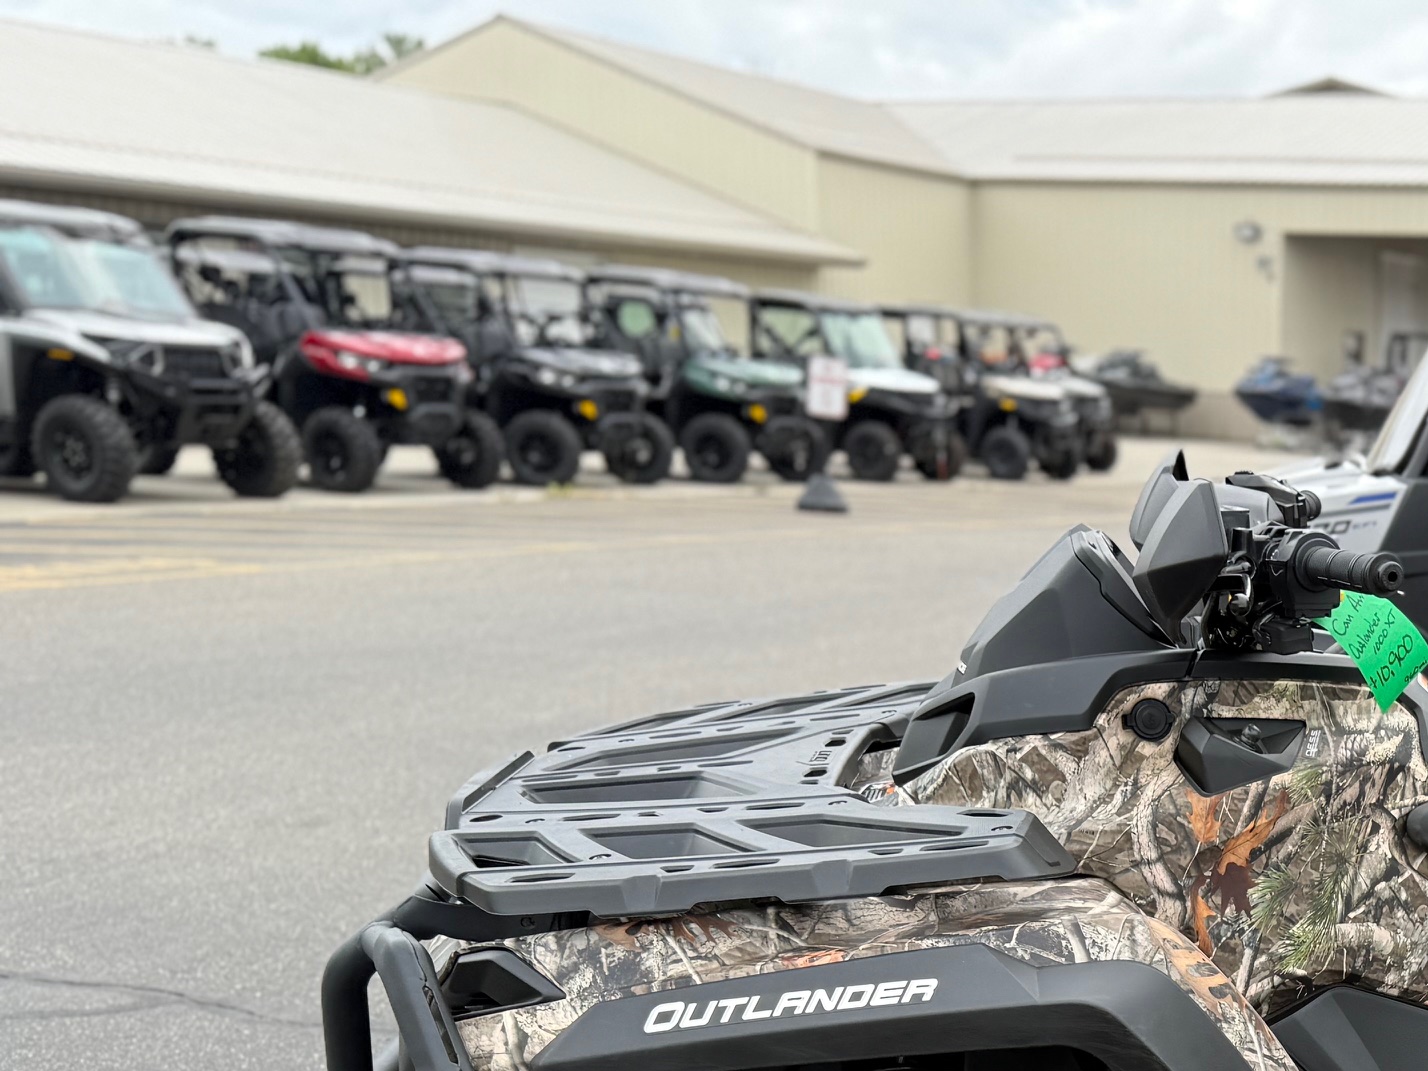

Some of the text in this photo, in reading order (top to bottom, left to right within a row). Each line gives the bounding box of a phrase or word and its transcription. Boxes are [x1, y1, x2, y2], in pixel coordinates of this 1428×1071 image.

[1332, 615, 1355, 637] Can
[1348, 611, 1382, 660] Outlander
[643, 978, 939, 1034] OUTLANDER
